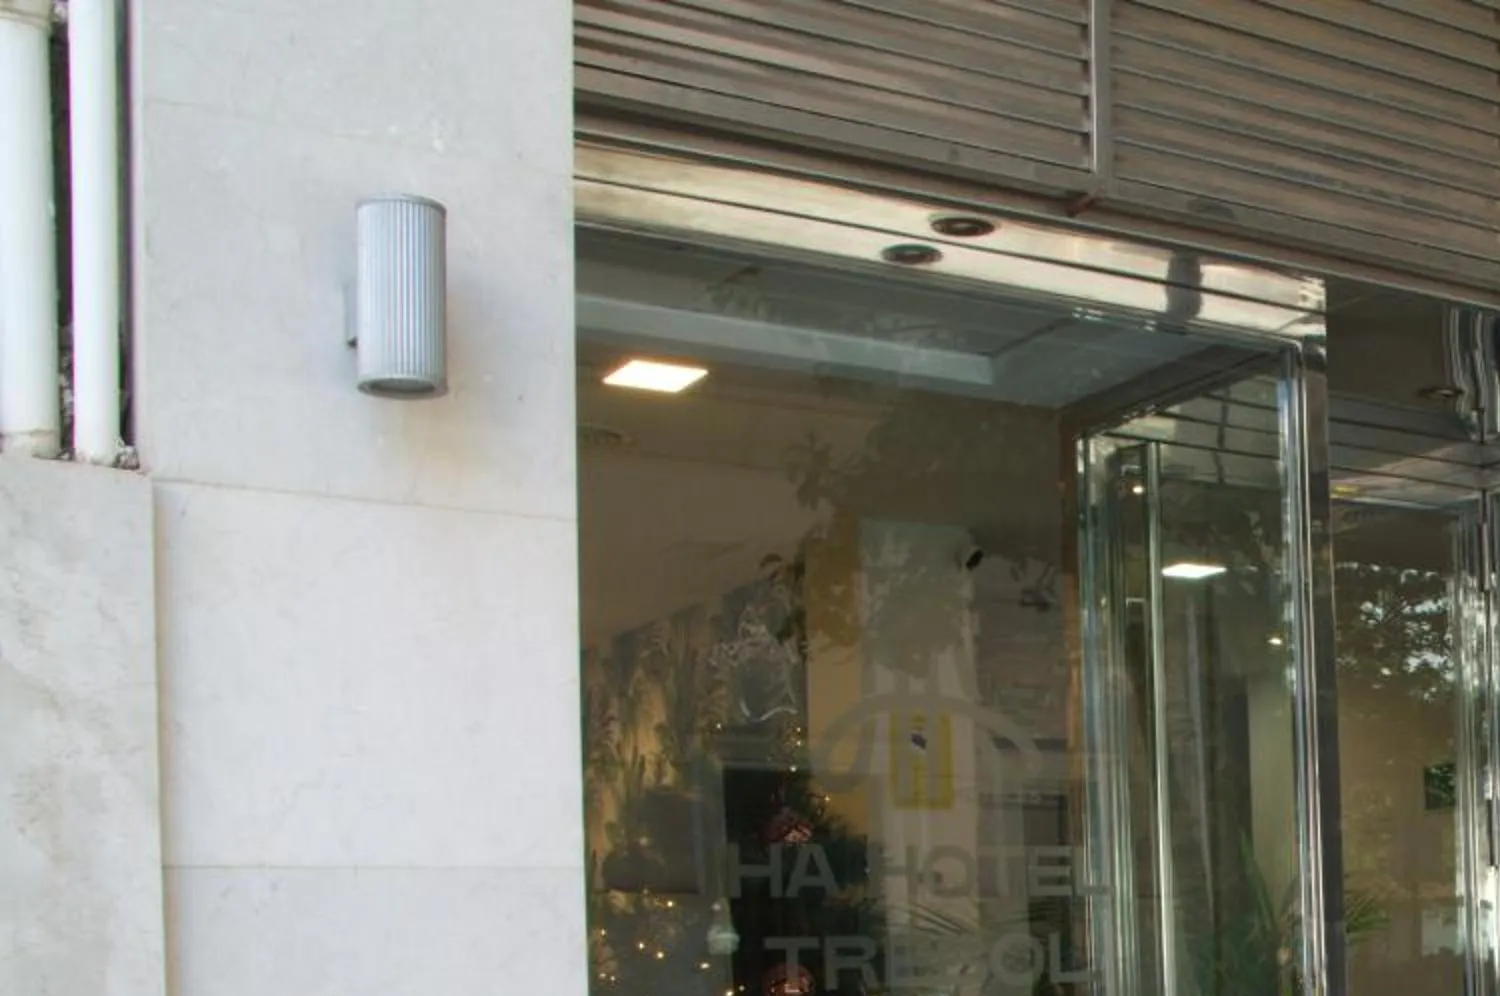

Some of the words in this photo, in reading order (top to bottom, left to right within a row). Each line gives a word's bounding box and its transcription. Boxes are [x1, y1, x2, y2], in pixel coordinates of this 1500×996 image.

[727, 842, 841, 899] HA
[868, 842, 1113, 899] HOTEL
[762, 933, 1102, 991] TREOL
